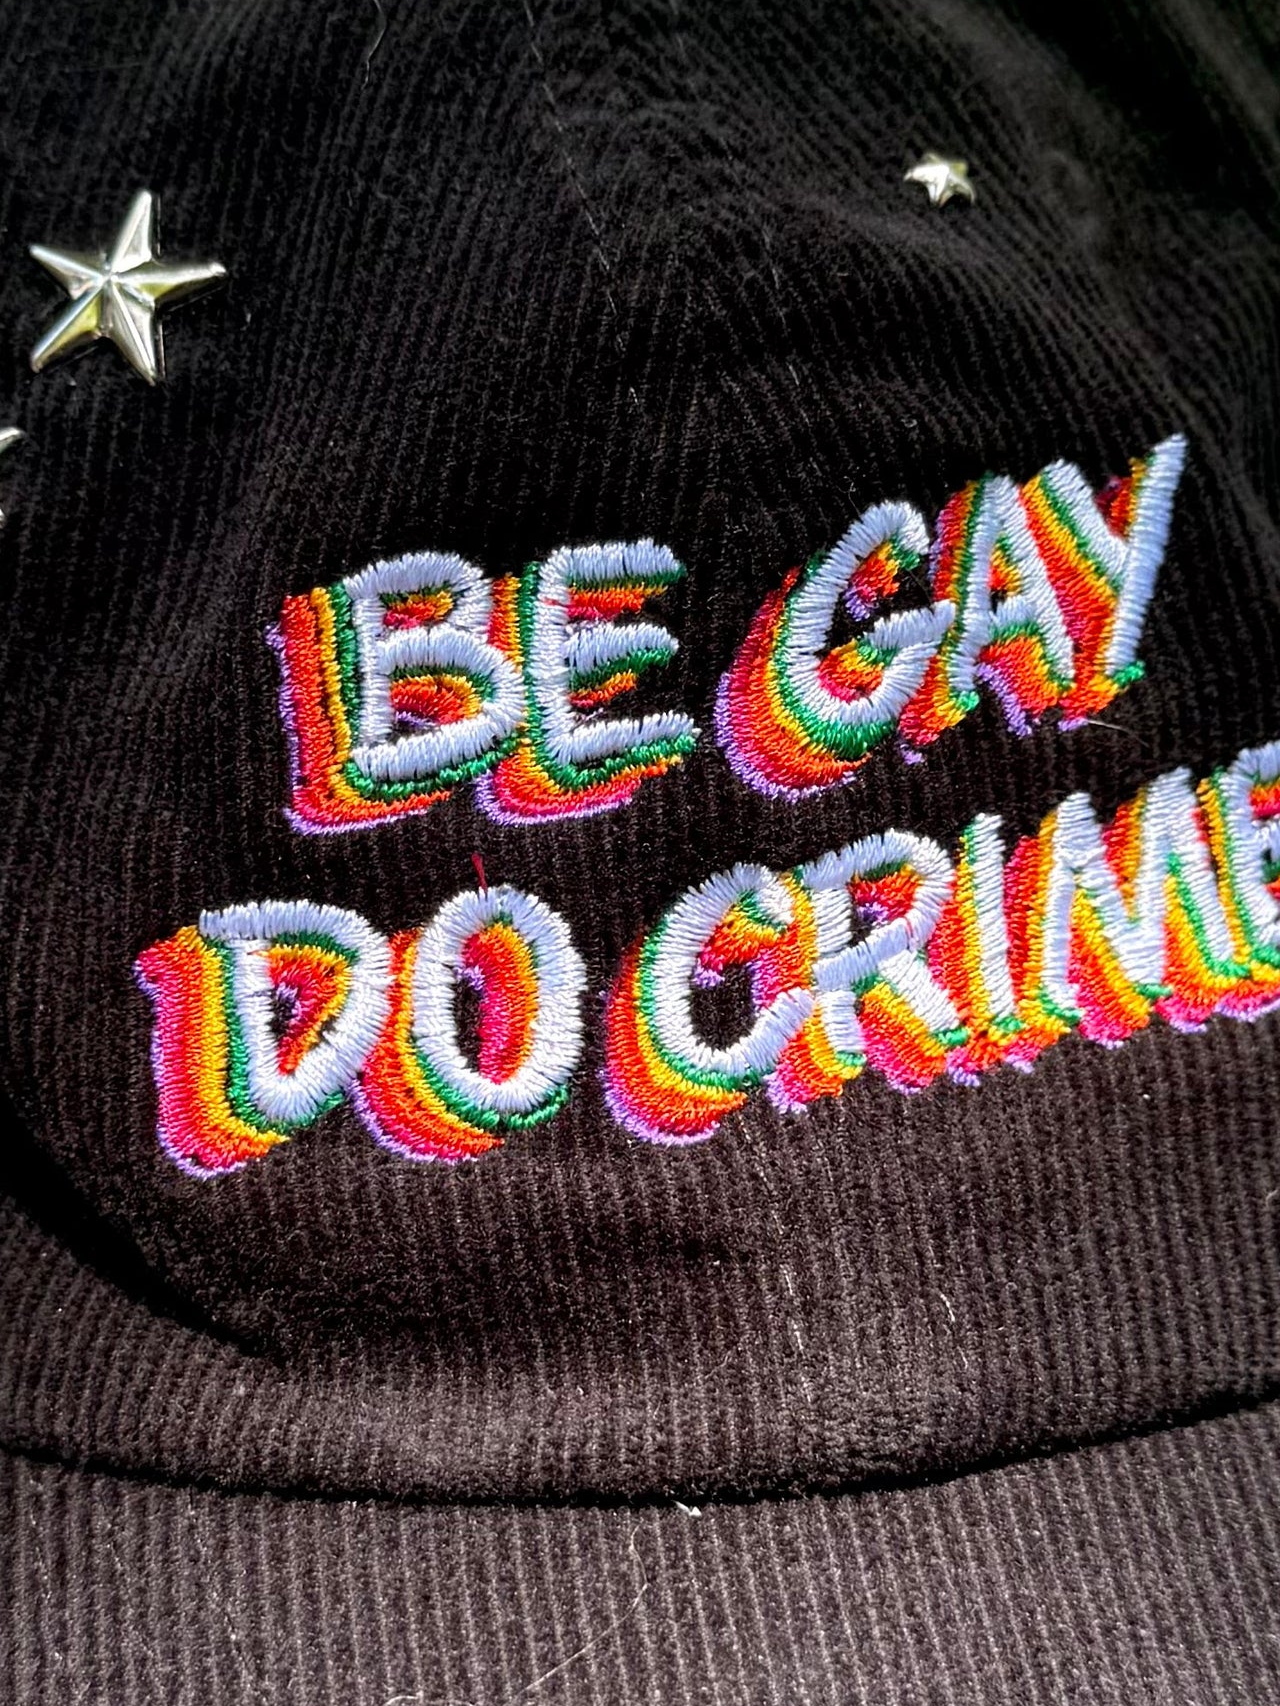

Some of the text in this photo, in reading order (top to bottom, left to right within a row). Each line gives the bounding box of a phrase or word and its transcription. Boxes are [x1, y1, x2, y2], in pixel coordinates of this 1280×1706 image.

[270, 434, 1186, 833] BE GAY
[137, 885, 586, 1177] DO
